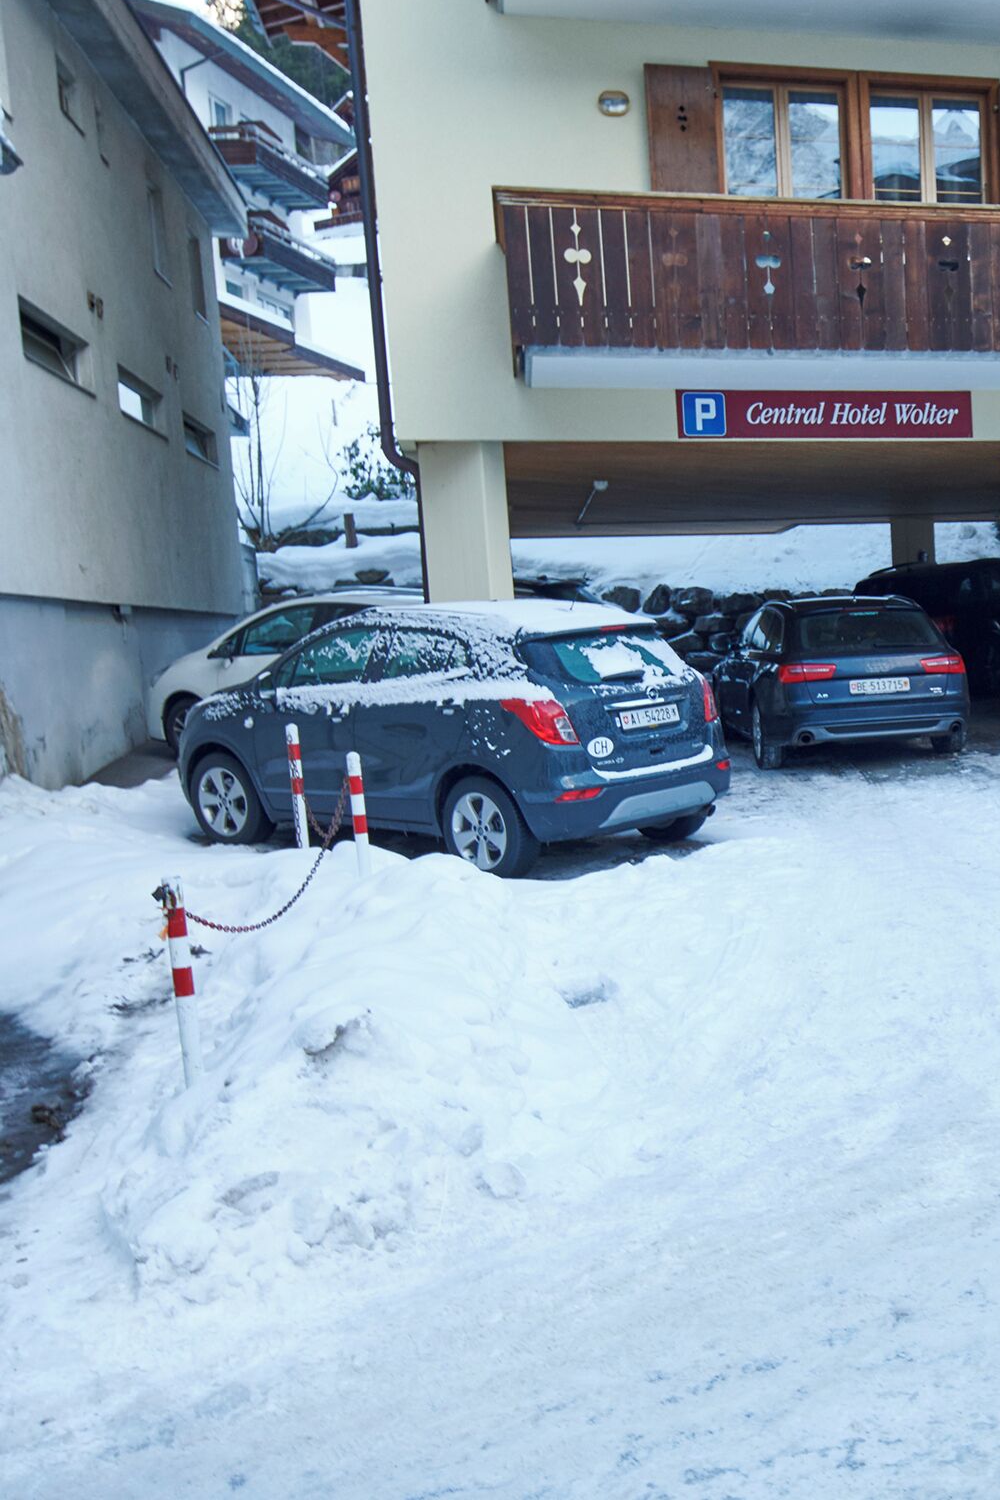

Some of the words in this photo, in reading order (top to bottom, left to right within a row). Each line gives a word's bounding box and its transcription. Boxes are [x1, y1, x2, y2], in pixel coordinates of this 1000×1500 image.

[695, 398, 717, 431] P
[746, 401, 825, 425] Central
[831, 401, 887, 425] Hotel
[894, 402, 959, 425] Wolter
[594, 740, 608, 755] CH
